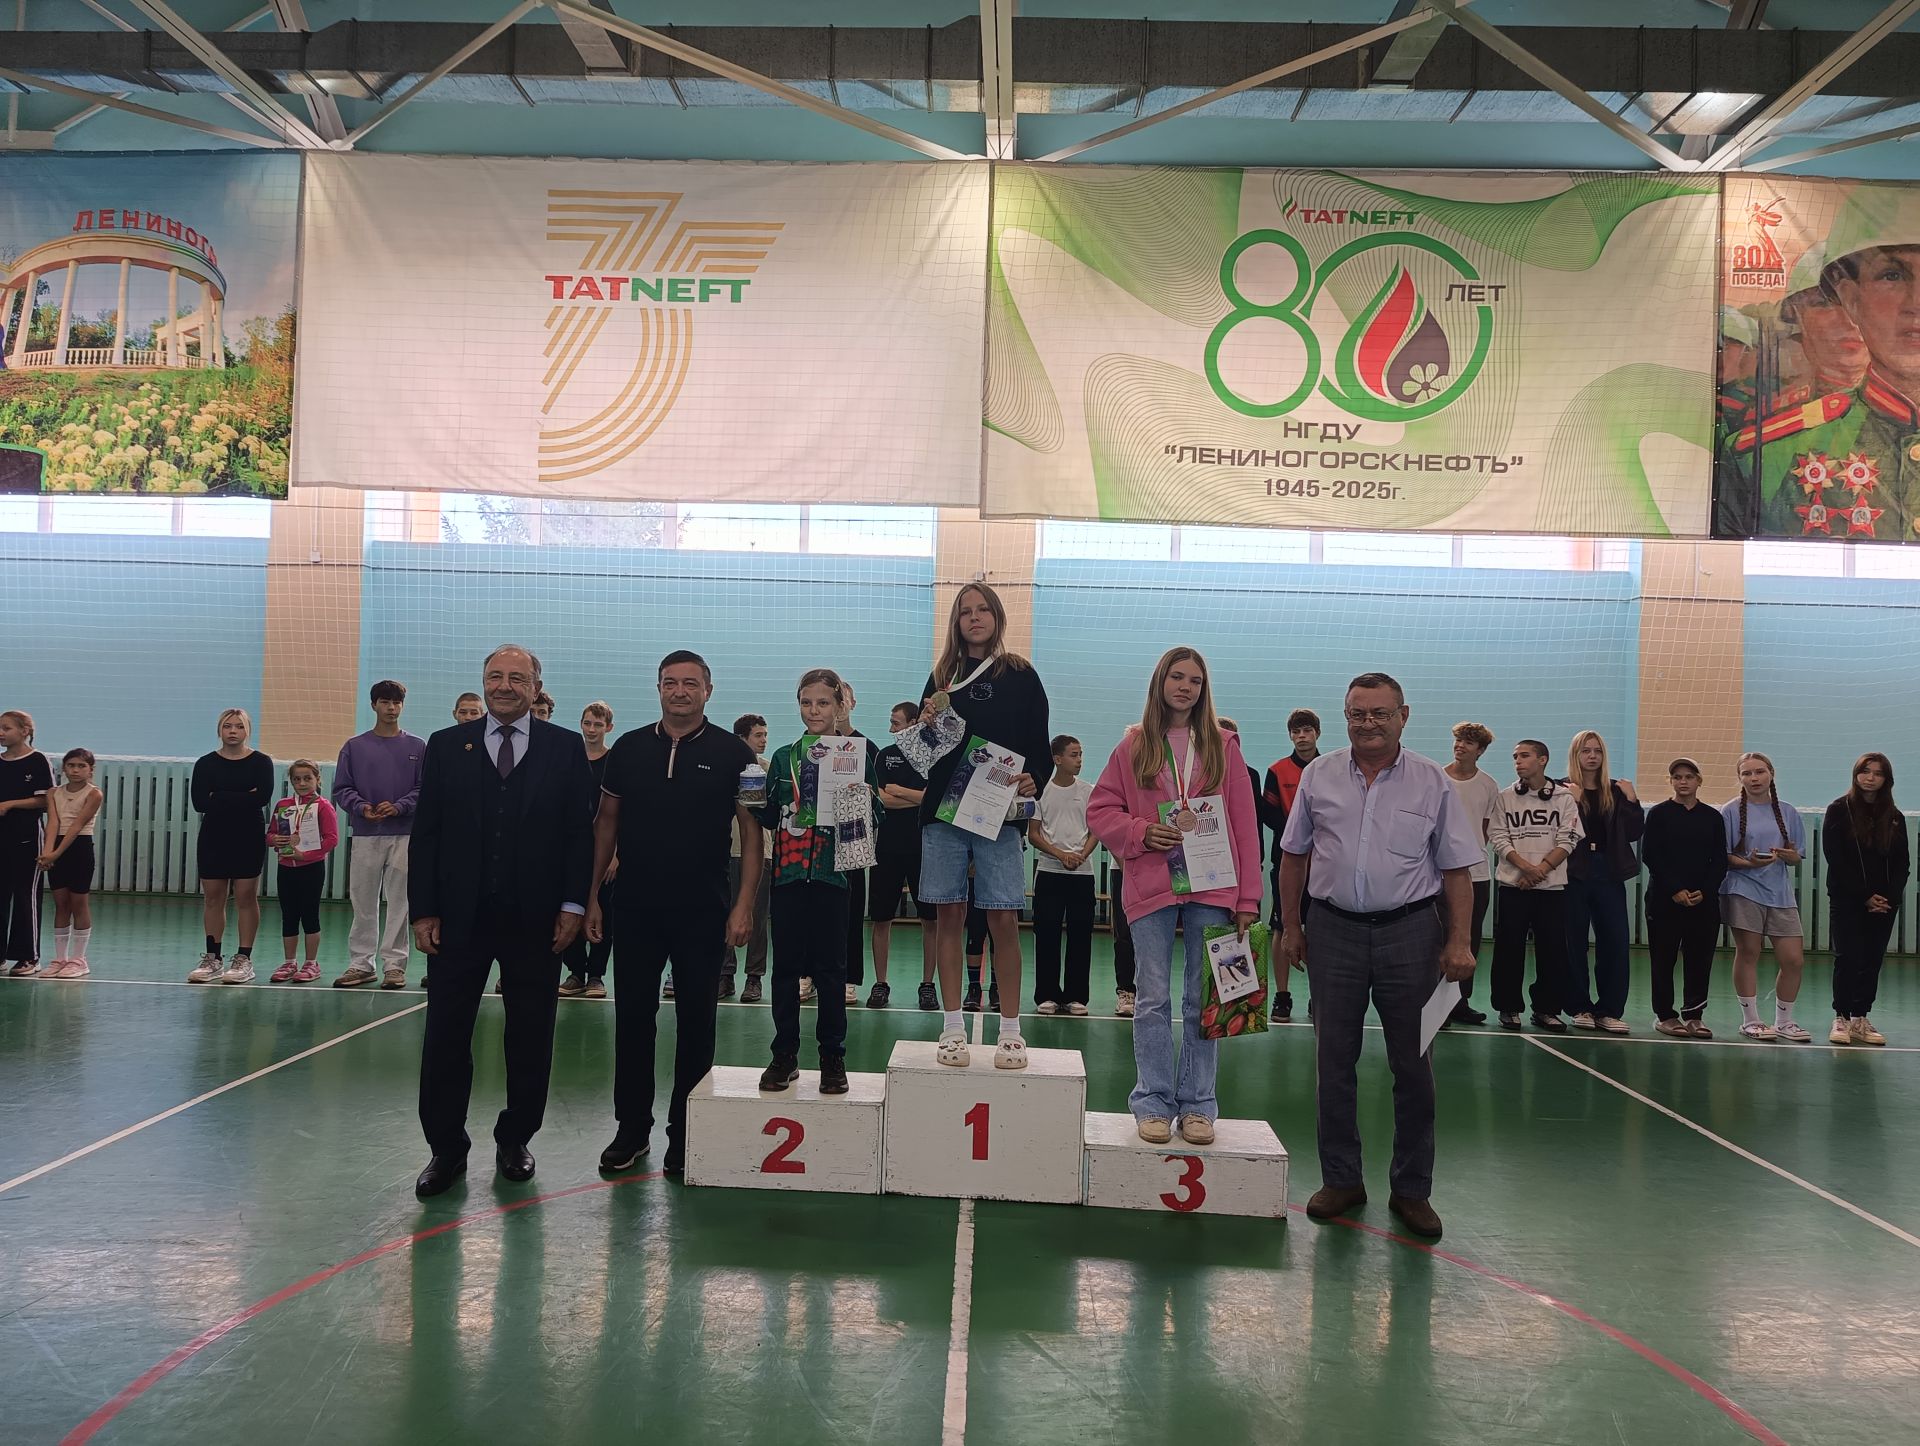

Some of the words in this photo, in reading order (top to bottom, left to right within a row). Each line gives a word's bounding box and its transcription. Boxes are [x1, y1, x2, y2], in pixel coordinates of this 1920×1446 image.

[1300, 209, 1420, 225] TATNEFT
[1733, 245, 1761, 269] 80
[545, 275, 751, 303] TATNEFT
[1732, 273, 1785, 287] ПОБЕДА!
[1445, 284, 1506, 303] ЛЕТ
[1283, 421, 1362, 443] НГДУ
[1263, 478, 1406, 500] 1945-2025г.
[1506, 809, 1560, 828] NASA
[964, 1103, 990, 1160] 1
[760, 1117, 806, 1174] 2
[1159, 1155, 1206, 1212] 3
